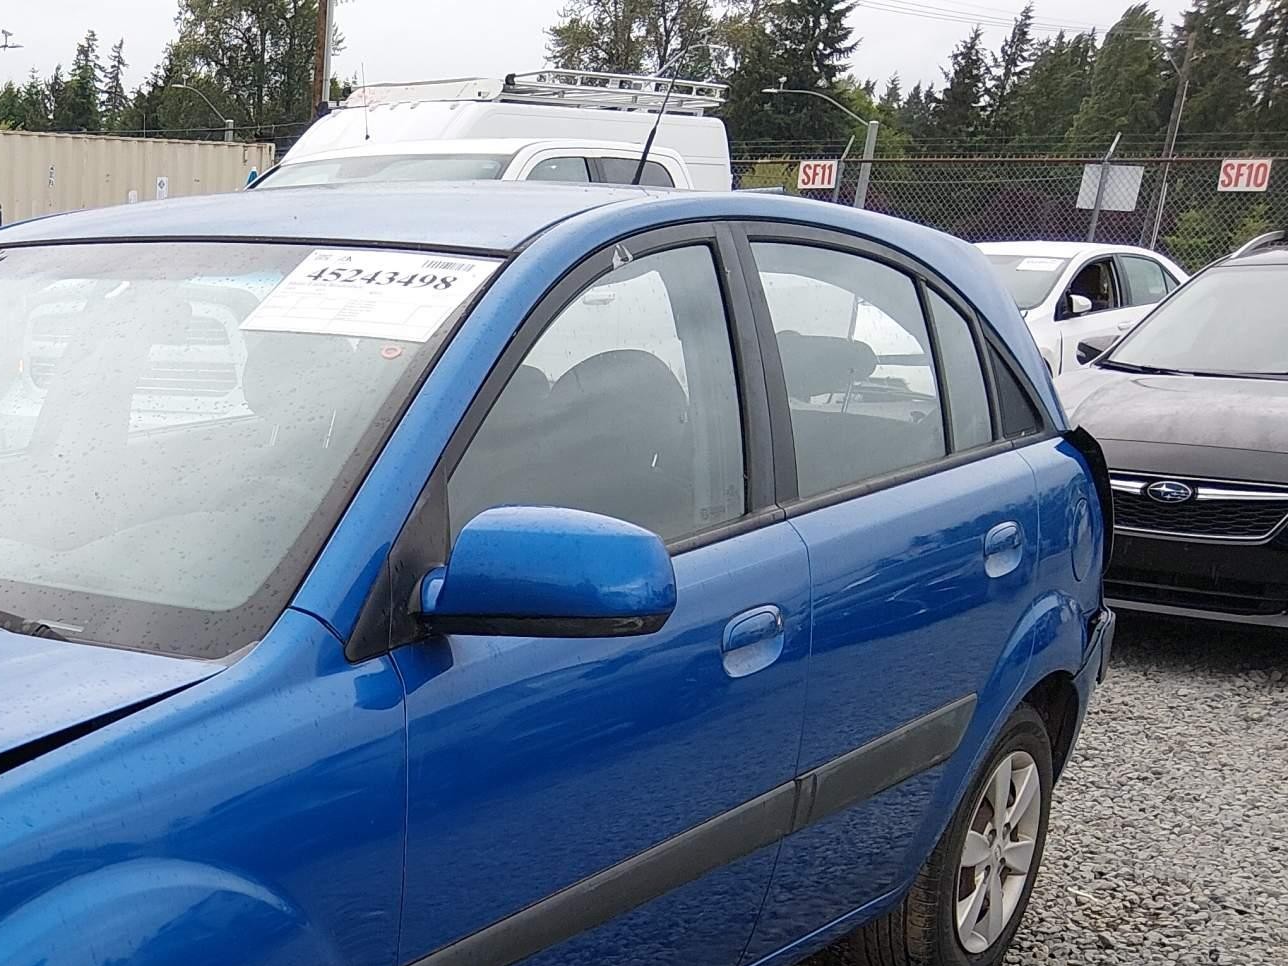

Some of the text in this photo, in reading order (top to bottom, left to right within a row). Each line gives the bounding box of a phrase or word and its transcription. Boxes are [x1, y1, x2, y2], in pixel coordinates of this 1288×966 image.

[801, 163, 833, 186] SF11
[1220, 162, 1268, 188] SF10
[306, 266, 458, 291] 45243498
